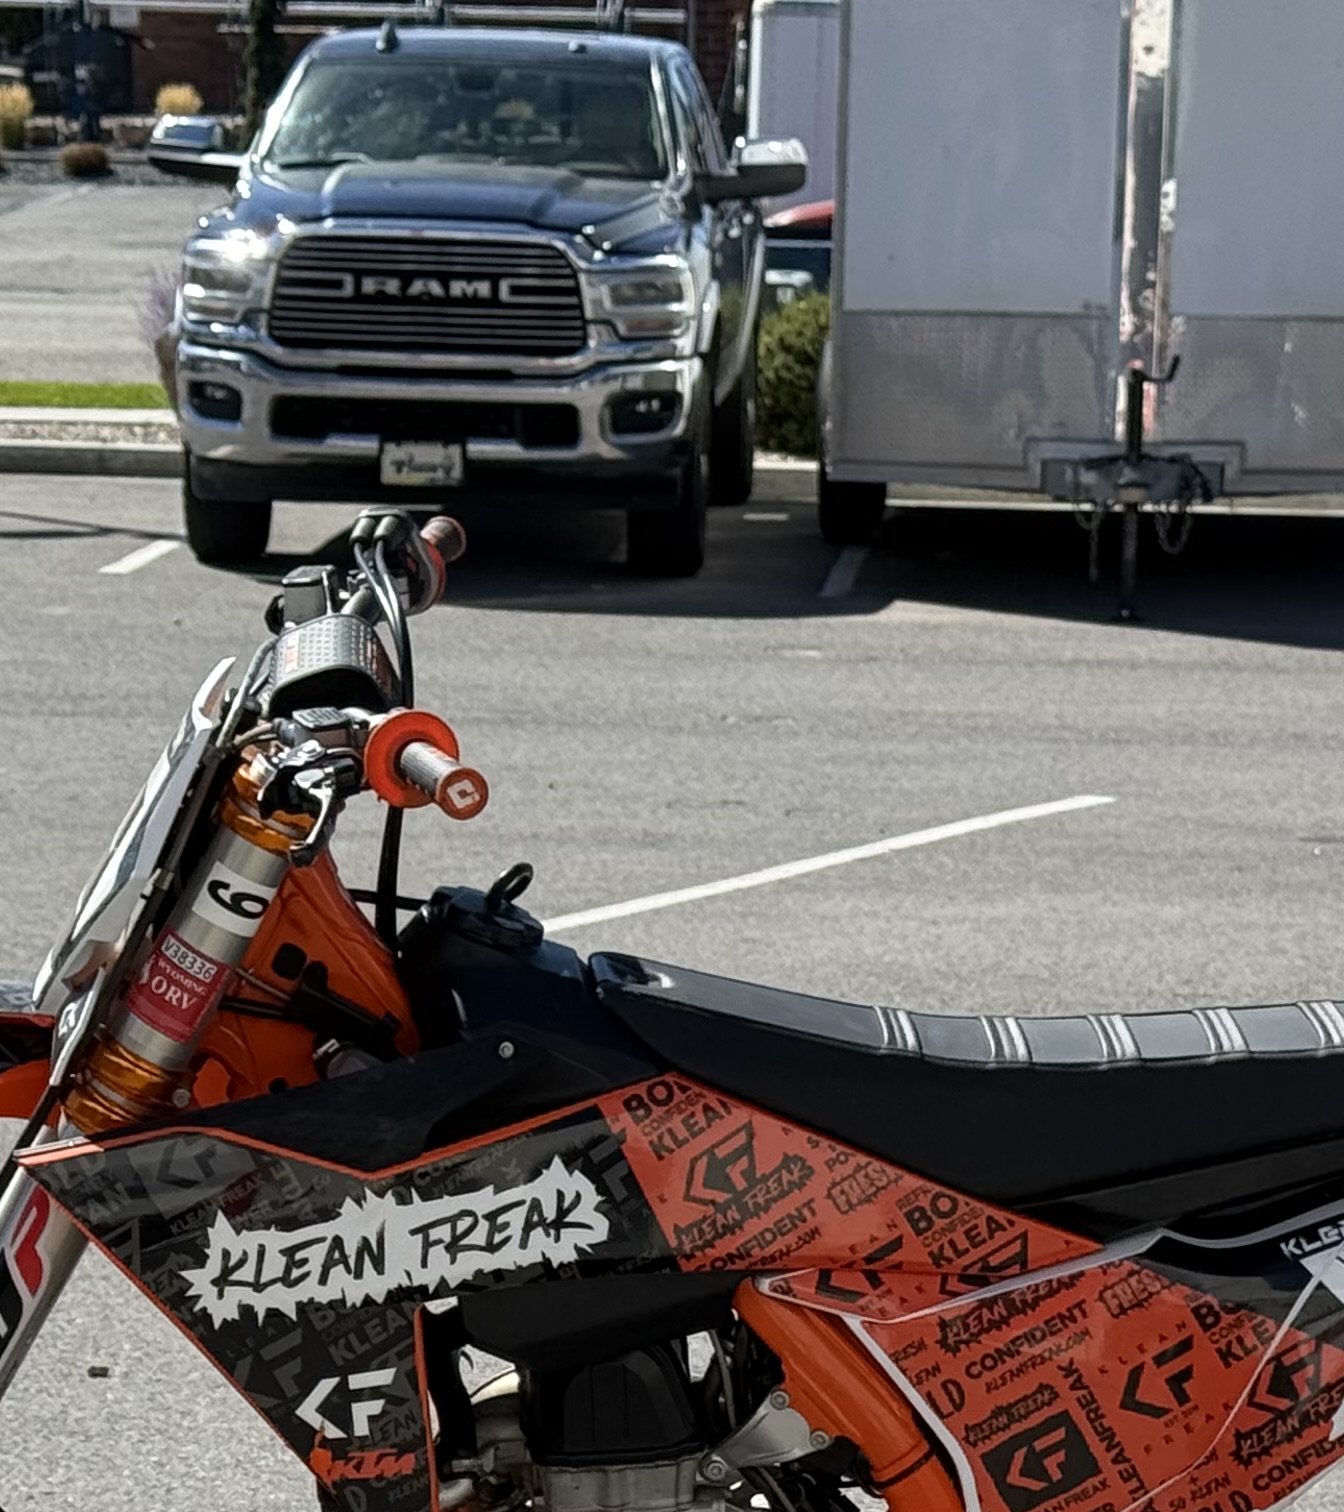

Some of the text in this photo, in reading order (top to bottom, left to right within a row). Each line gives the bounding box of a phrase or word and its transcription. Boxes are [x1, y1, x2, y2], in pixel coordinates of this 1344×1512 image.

[360, 275, 492, 299] RAM
[163, 938, 217, 980] V38336
[151, 974, 196, 1010] ORV
[622, 1080, 692, 1126] BO
[681, 1157, 812, 1250] KLEAN FREAK
[905, 1193, 960, 1237] BO
[211, 1189, 594, 1300] KLEAN FREAK
[965, 1299, 1089, 1380] CONFIDENT
[328, 1448, 416, 1481] KTM
[1065, 1477, 1111, 1508] FREAK
